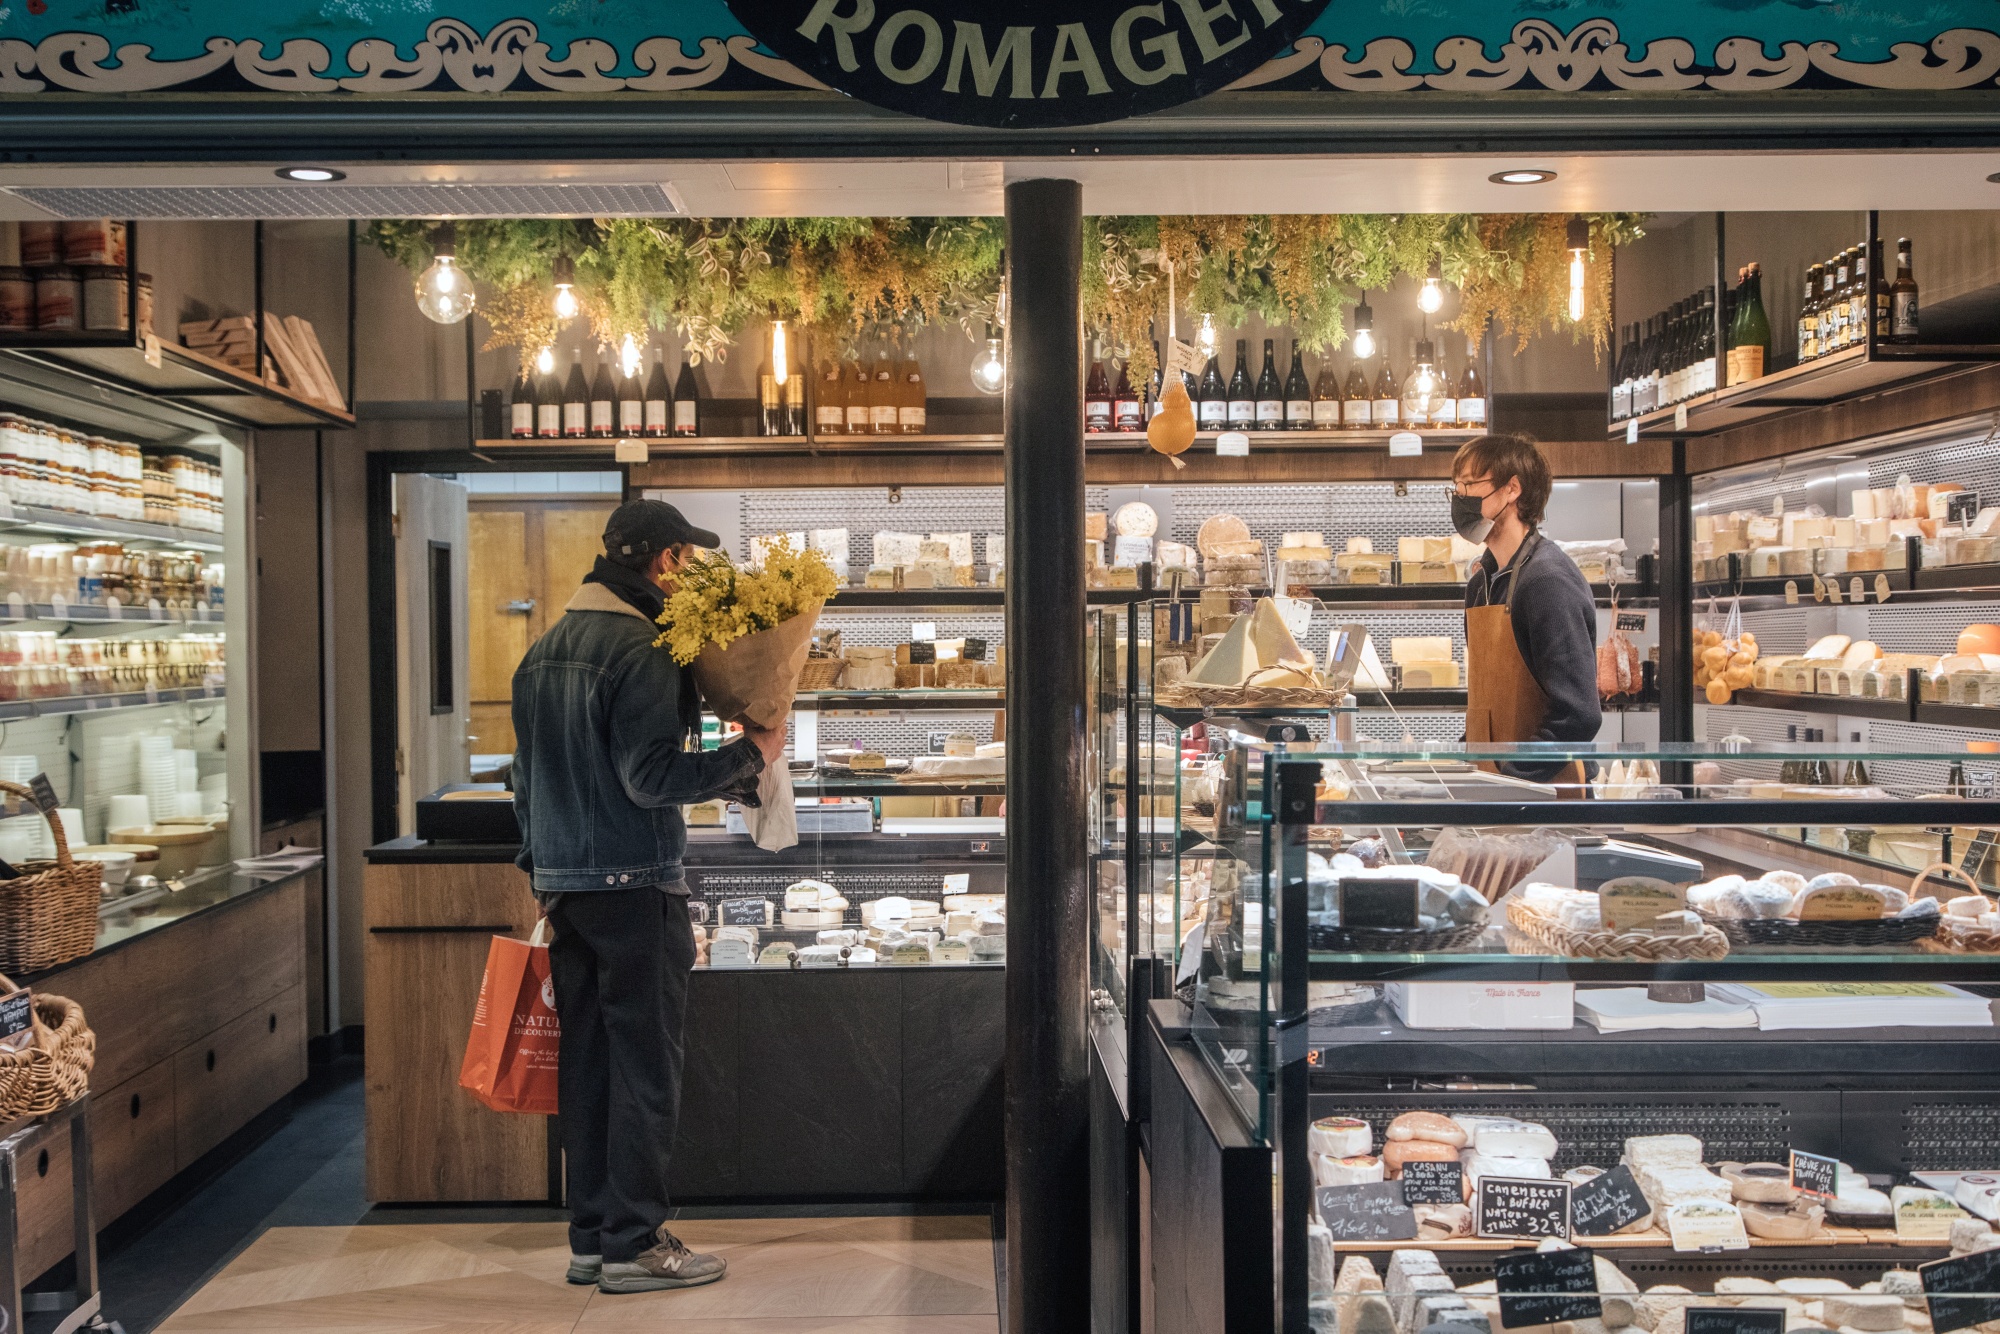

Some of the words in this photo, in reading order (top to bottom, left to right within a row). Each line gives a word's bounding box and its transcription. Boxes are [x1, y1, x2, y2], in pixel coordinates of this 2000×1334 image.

[1486, 988, 1506, 998] Made
[1516, 988, 1541, 997] France
[1412, 1162, 1448, 1172] CASANU
[1794, 1156, 1819, 1171] CHÈVRE
[1486, 1184, 1562, 1198] CAMEMBERT
[1510, 1197, 1550, 1210] BUFALA
